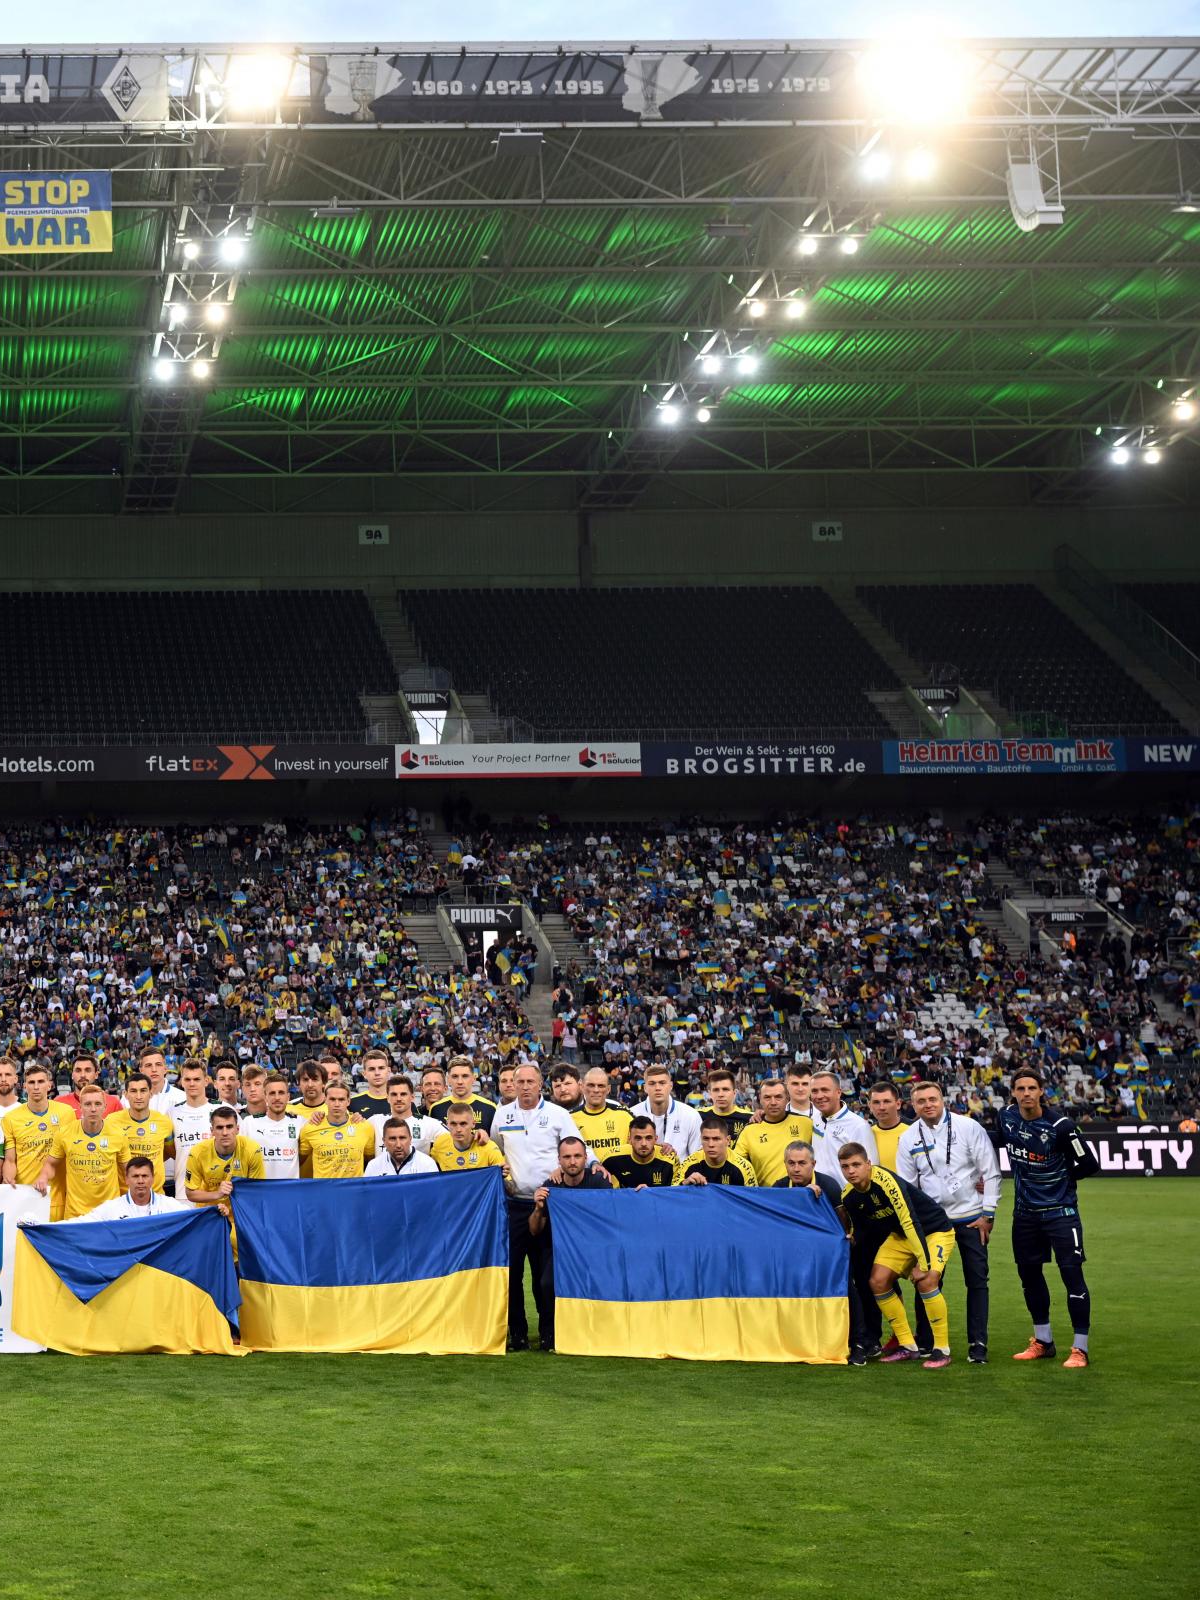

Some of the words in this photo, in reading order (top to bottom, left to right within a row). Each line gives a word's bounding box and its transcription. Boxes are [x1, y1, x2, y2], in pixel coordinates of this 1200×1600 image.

[412, 80, 463, 96] 1960
[485, 80, 533, 96] 1973
[554, 79, 604, 95] 1995
[711, 78, 760, 94] 1975
[781, 77, 831, 93] 1979
[5, 180, 90, 205] STOP
[5, 217, 90, 246] WAR
[366, 530, 382, 539] 9A
[696, 746, 713, 755] Der
[716, 746, 742, 755] Wein
[746, 746, 754, 755] &
[757, 745, 779, 755] Sekt
[788, 745, 806, 755] seit
[809, 745, 835, 755] 1600
[899, 741, 999, 762] Heinrich
[472, 754, 493, 763] Your
[497, 753, 531, 765] Project
[535, 753, 571, 762] Partner
[274, 758, 315, 770] Invest
[319, 758, 331, 770] in
[334, 757, 389, 776] yourself
[899, 765, 976, 773] Bauunternehmen
[987, 764, 1031, 773] Baustoffe
[1062, 764, 1083, 772] GmbH
[451, 909, 495, 923] PUMA
[1051, 913, 1075, 921] PUMA
[586, 1138, 620, 1148] PICENTR
